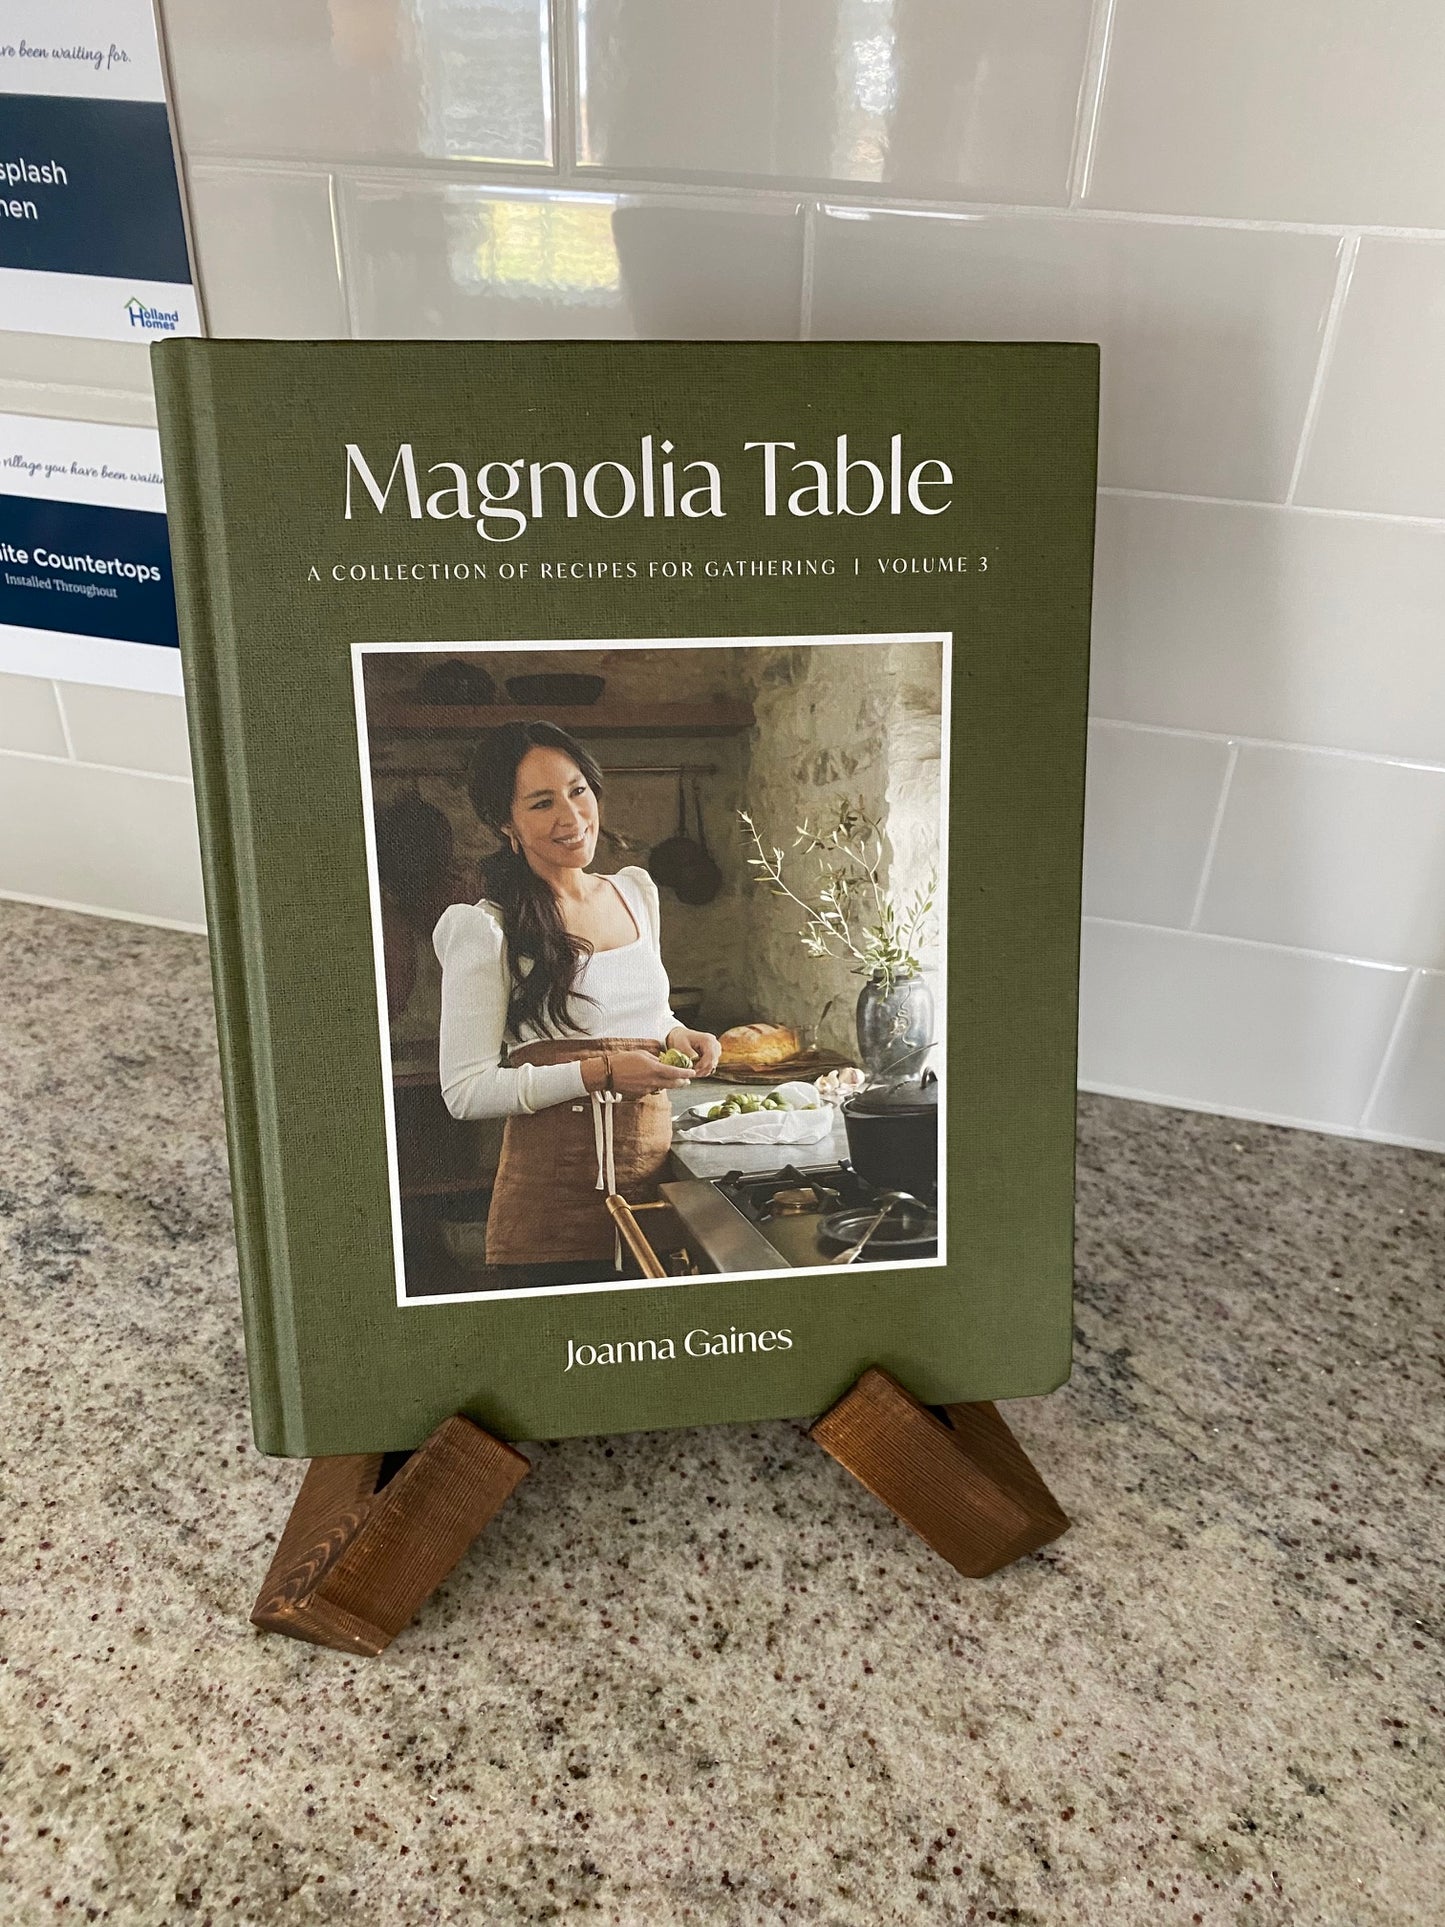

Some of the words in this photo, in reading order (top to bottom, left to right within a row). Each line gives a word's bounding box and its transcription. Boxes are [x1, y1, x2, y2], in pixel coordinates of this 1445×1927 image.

[0, 45, 16, 58] ve
[19, 40, 49, 58] been
[52, 46, 104, 70] waiting
[107, 44, 131, 70] for.
[129, 307, 179, 327] Holland
[3, 455, 42, 476] village
[44, 464, 67, 478] you
[70, 461, 99, 477] have
[101, 464, 128, 480] been
[344, 434, 727, 542] Magnolia
[743, 433, 954, 517] Table
[0, 543, 29, 564] ite
[33, 547, 161, 583] Countertops
[307, 566, 321, 581] A
[332, 564, 487, 581] COLLECTION
[498, 563, 529, 579] OF
[541, 562, 637, 579] RECIPES
[649, 561, 694, 577] FOR
[705, 560, 836, 577] GATHERING
[878, 557, 967, 574] VOLUME
[978, 556, 988, 572] 3
[5, 572, 52, 590] Installed
[53, 578, 118, 598] Throughout
[564, 1338, 676, 1373] Joanna
[684, 1326, 794, 1357] Gaines
